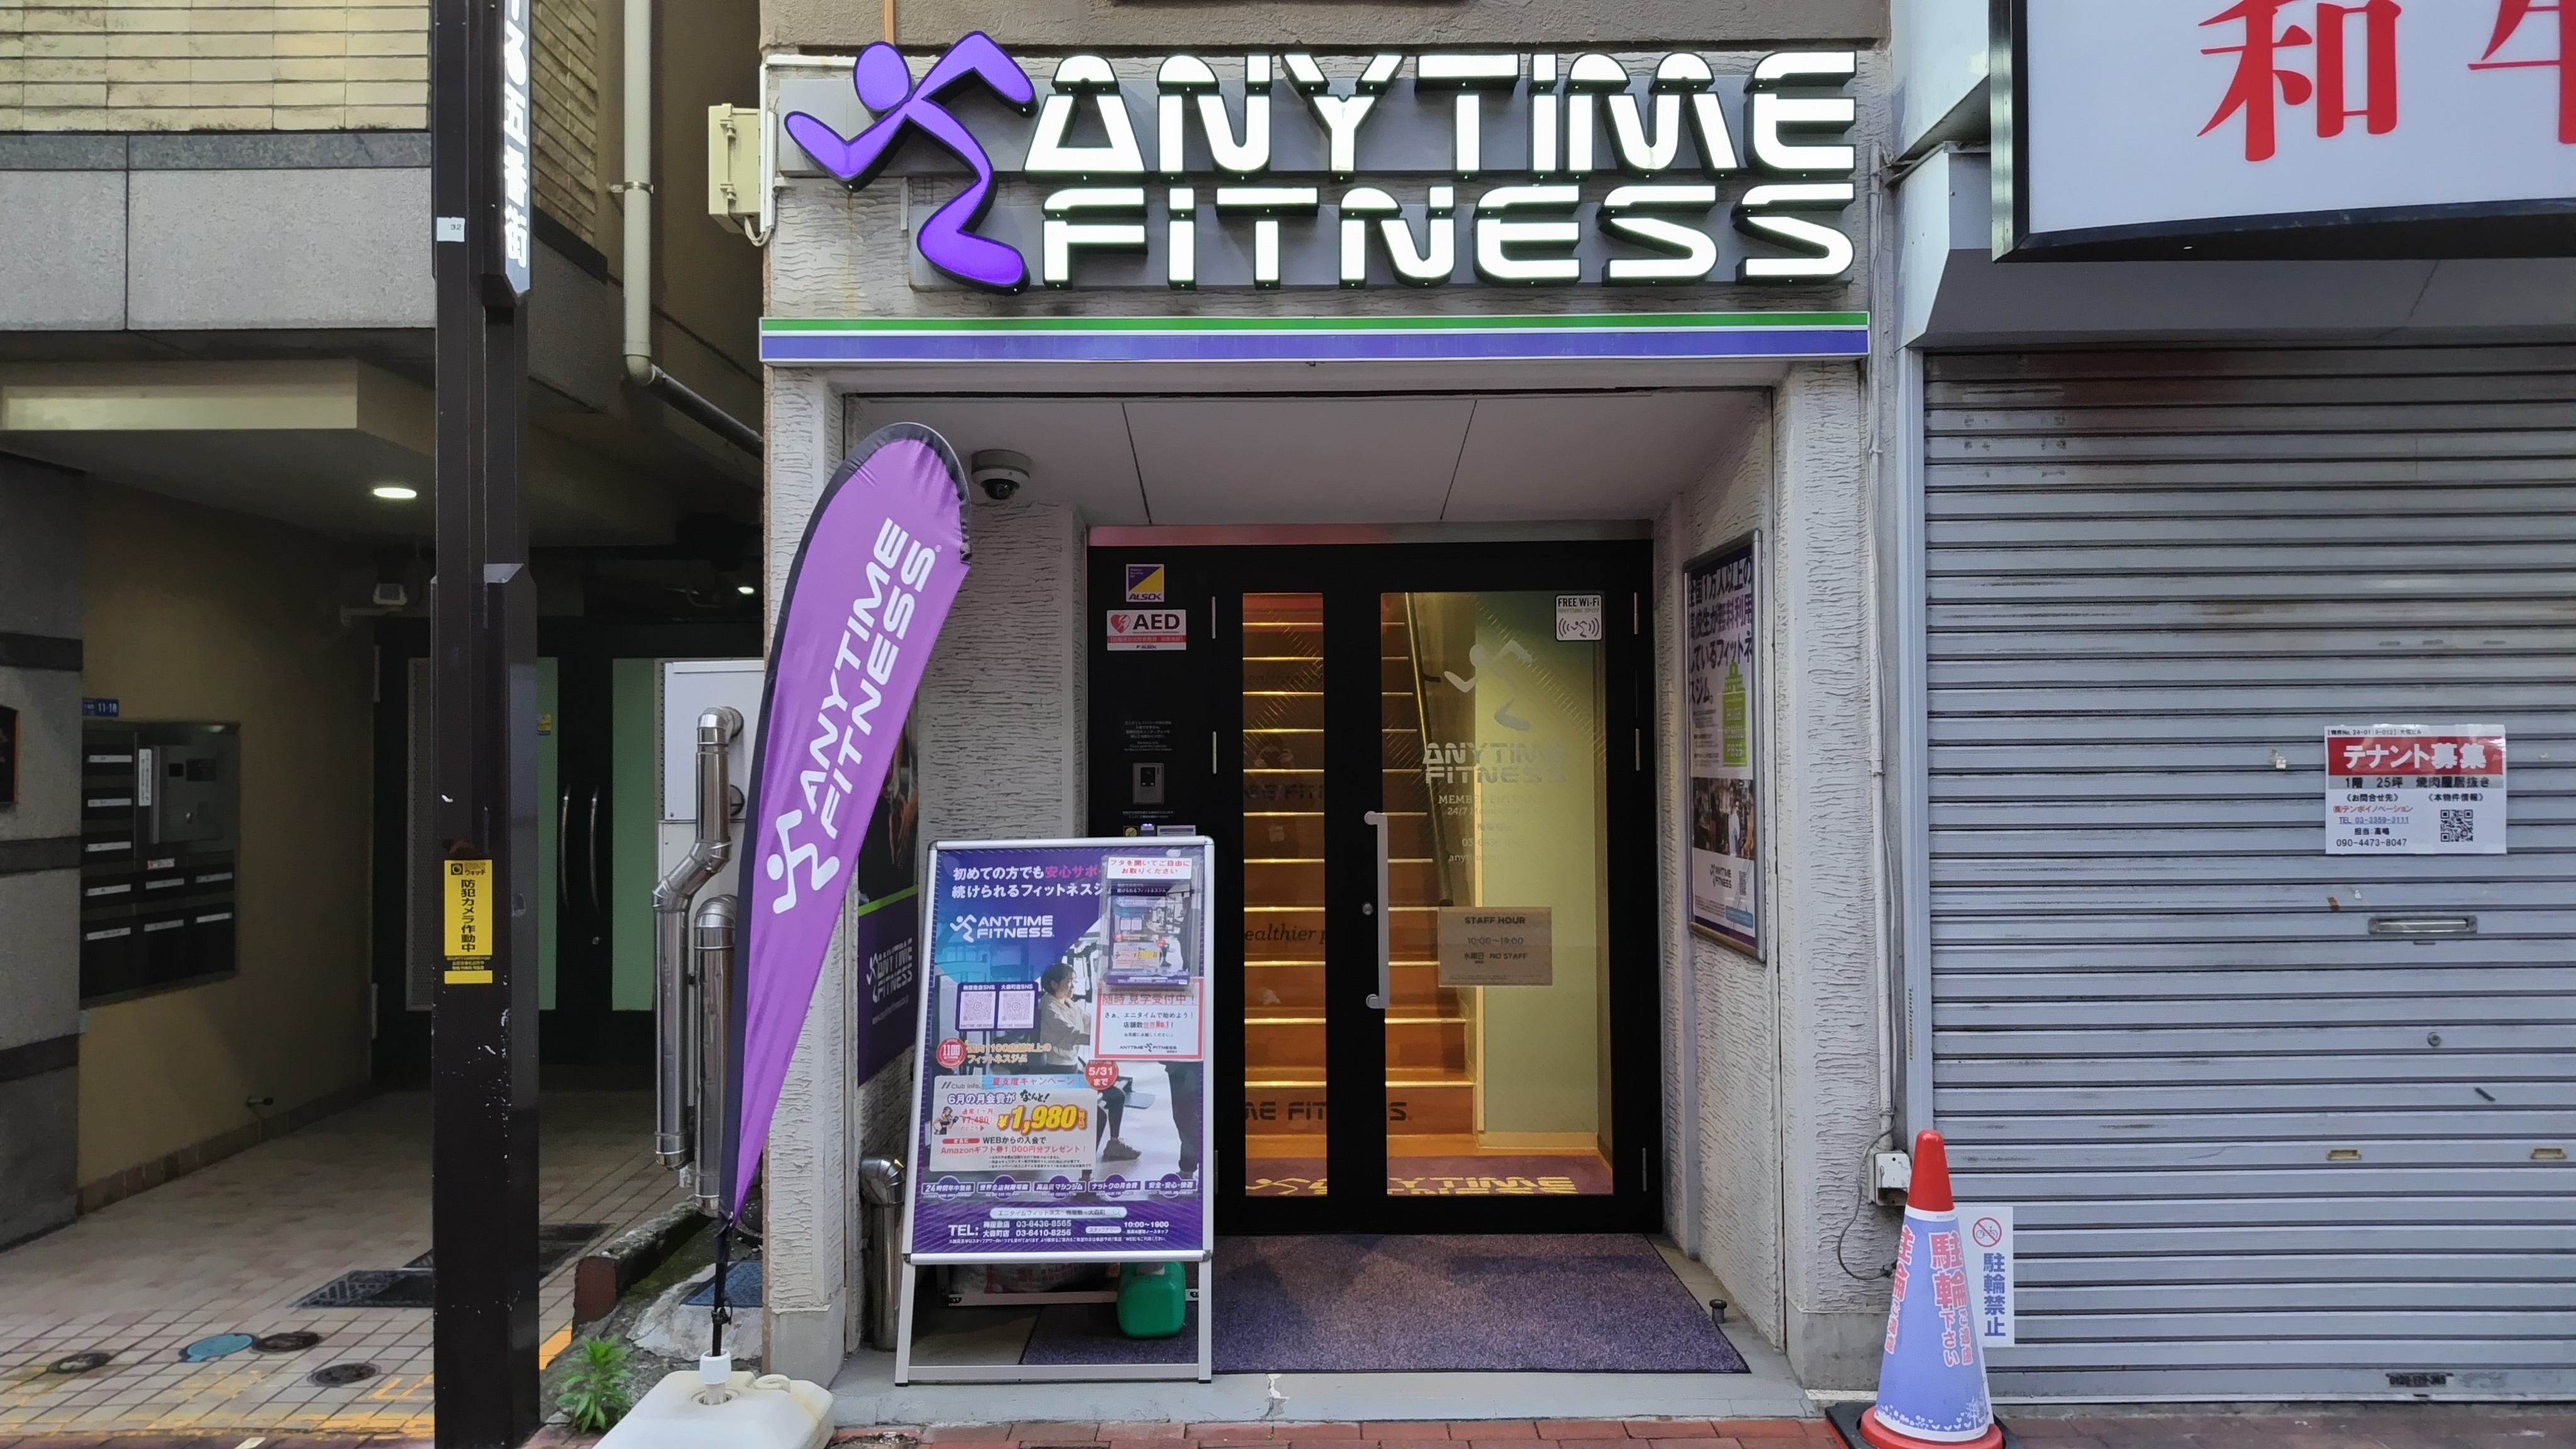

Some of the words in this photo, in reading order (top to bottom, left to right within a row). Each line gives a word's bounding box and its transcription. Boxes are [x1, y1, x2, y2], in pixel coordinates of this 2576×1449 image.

[1024, 52, 1856, 182] ANYTIME
[1042, 182, 1856, 288] FITNESS
[1558, 598, 1577, 607] FREE
[1579, 597, 1599, 606] Wi-Fi
[1133, 614, 1180, 630] AED
[800, 518, 908, 814] ANYTIME
[820, 540, 937, 840] FITNESS
[2343, 743, 2486, 769] テナント募集
[2345, 777, 2363, 789] 1階
[2376, 777, 2403, 788] 25坪
[2416, 777, 2490, 788] 焼肉屋居抜き
[461, 879, 475, 952] 防犯カメラ作動中
[979, 915, 1053, 926] ANYTIME
[1465, 916, 1495, 924] STAFF
[1497, 916, 1526, 924] HOUR
[1245, 923, 1318, 941] ealthier
[877, 938, 913, 980] ANYTIME
[1463, 952, 1484, 960] 水曜日
[878, 962, 913, 1002] FITNESS
[1102, 994, 1126, 1006] 随時
[943, 1045, 960, 1057] 1100
[967, 1053, 1028, 1064] フィットネスジム
[1088, 1067, 1113, 1077] 5/31
[1093, 1079, 1108, 1087] まで
[947, 1092, 1016, 1105] 6月の月会費が
[997, 1105, 1077, 1135] ¥1,980
[983, 1136, 1046, 1145] WEBからの入会で
[925, 1184, 972, 1192] 24時間年中無休
[948, 1224, 979, 1236] TEL:
[1016, 1229, 1072, 1237] 03-6410-8256
[1983, 1253, 2006, 1337] 駐輪禁止
[1939, 1310, 1960, 1368] 下さい
